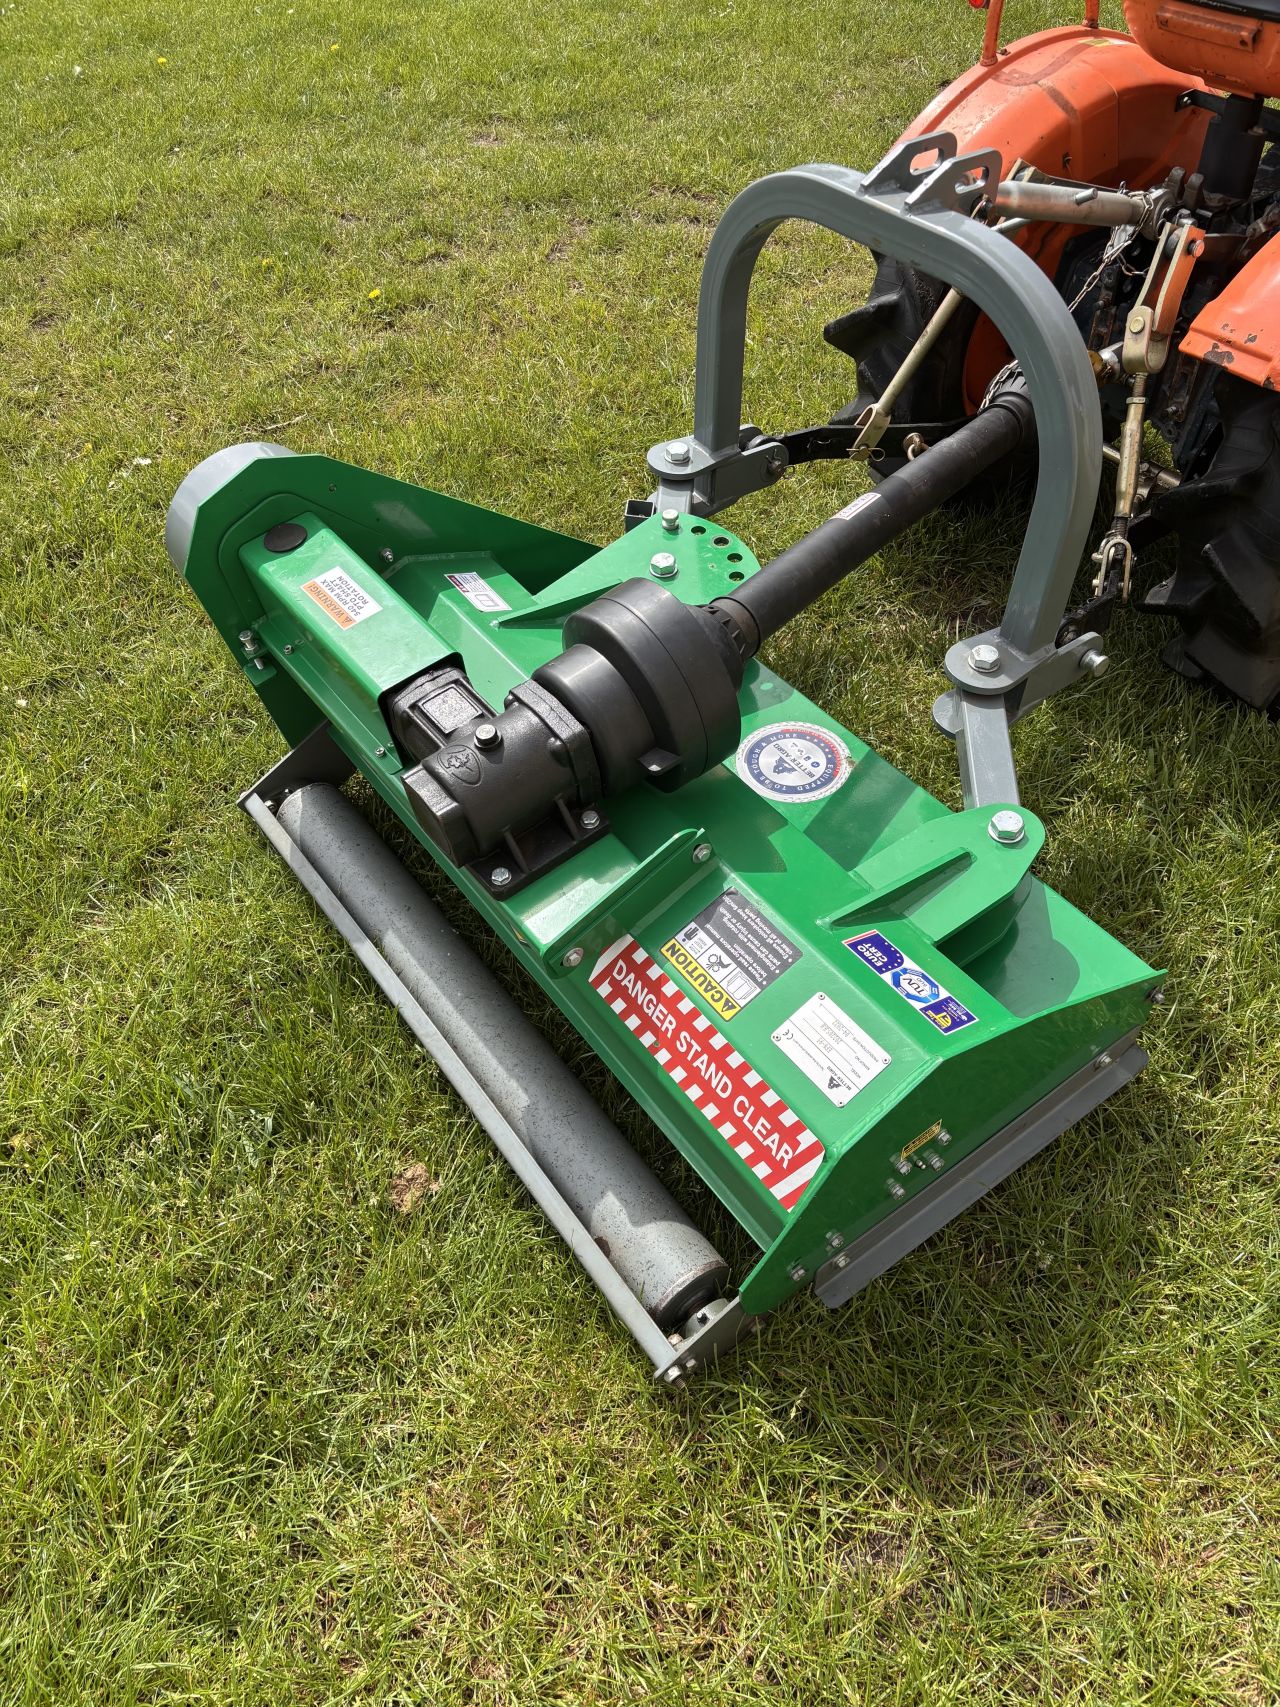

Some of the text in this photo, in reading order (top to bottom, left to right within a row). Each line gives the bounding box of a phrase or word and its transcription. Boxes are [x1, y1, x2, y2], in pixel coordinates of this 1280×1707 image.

[321, 579, 360, 616] 540 RPM MAX
[330, 580, 364, 610] PTO SHAFT
[337, 576, 368, 604] ROTATION
[308, 584, 344, 618] WARNING!
[720, 907, 731, 918] death
[705, 924, 721, 938] manual
[738, 932, 748, 942] with
[747, 918, 768, 938] onlookers
[748, 934, 760, 946] cause
[760, 946, 768, 954] can
[773, 943, 788, 959] Ensure
[857, 945, 884, 967] EURO
[863, 943, 888, 962] CERT
[734, 944, 767, 978] before operation
[738, 956, 749, 967] read
[768, 954, 781, 966] parts
[666, 943, 723, 1002] CAUTION
[748, 966, 763, 982] Please
[612, 960, 794, 1169] DANGER STAND CLEAR
[827, 1066, 851, 1090] BETTER AGRO
